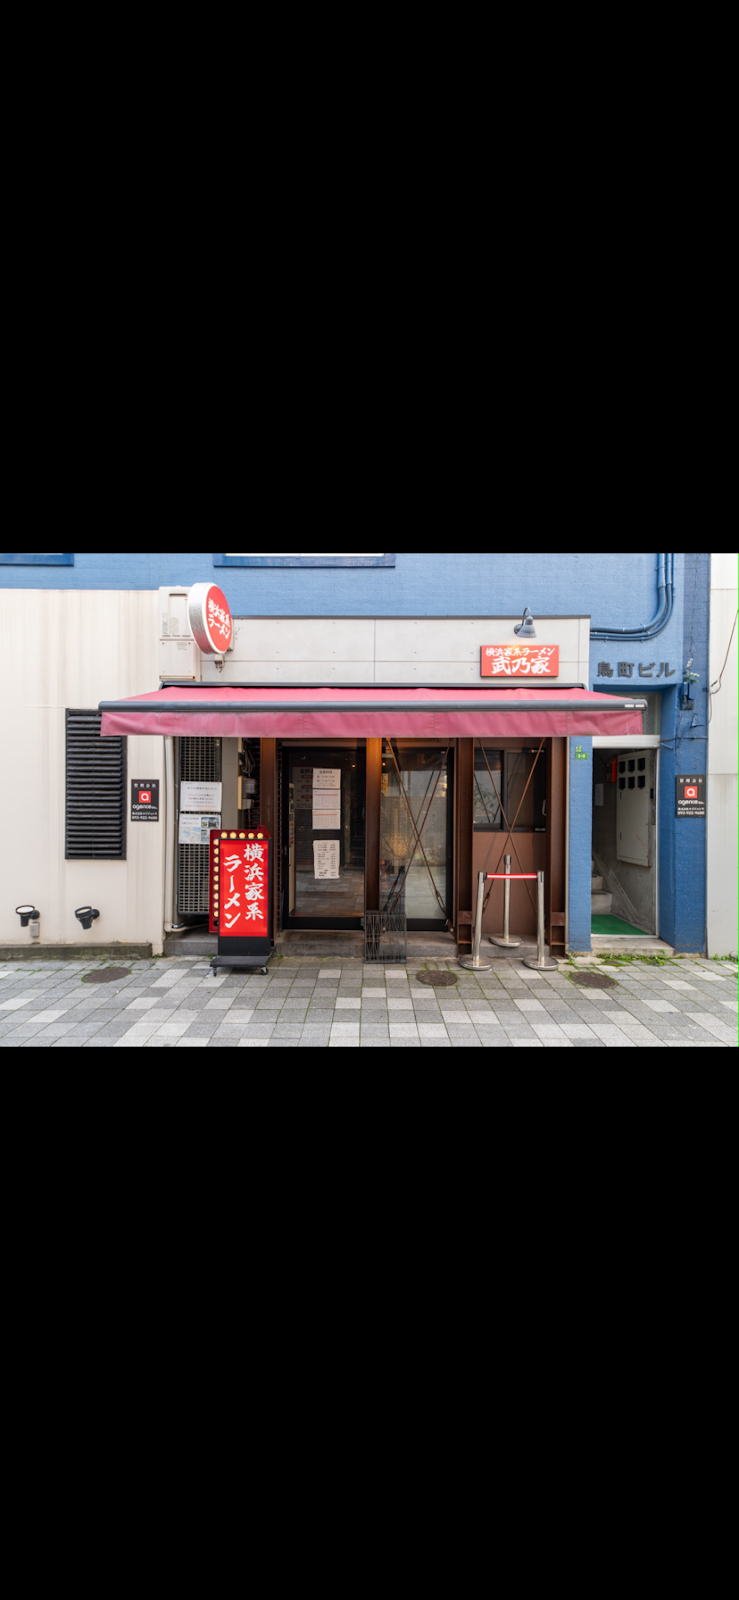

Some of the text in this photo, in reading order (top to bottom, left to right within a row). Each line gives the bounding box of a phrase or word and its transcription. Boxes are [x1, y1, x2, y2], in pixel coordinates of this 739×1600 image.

[208, 614, 231, 640] ラーメン
[485, 647, 555, 656] 横浜家系ラーメン
[491, 656, 551, 675] 武乃家
[597, 661, 676, 678] 鳥町ビル
[223, 854, 242, 929] ラーメン
[243, 843, 265, 921] 横浜家系
